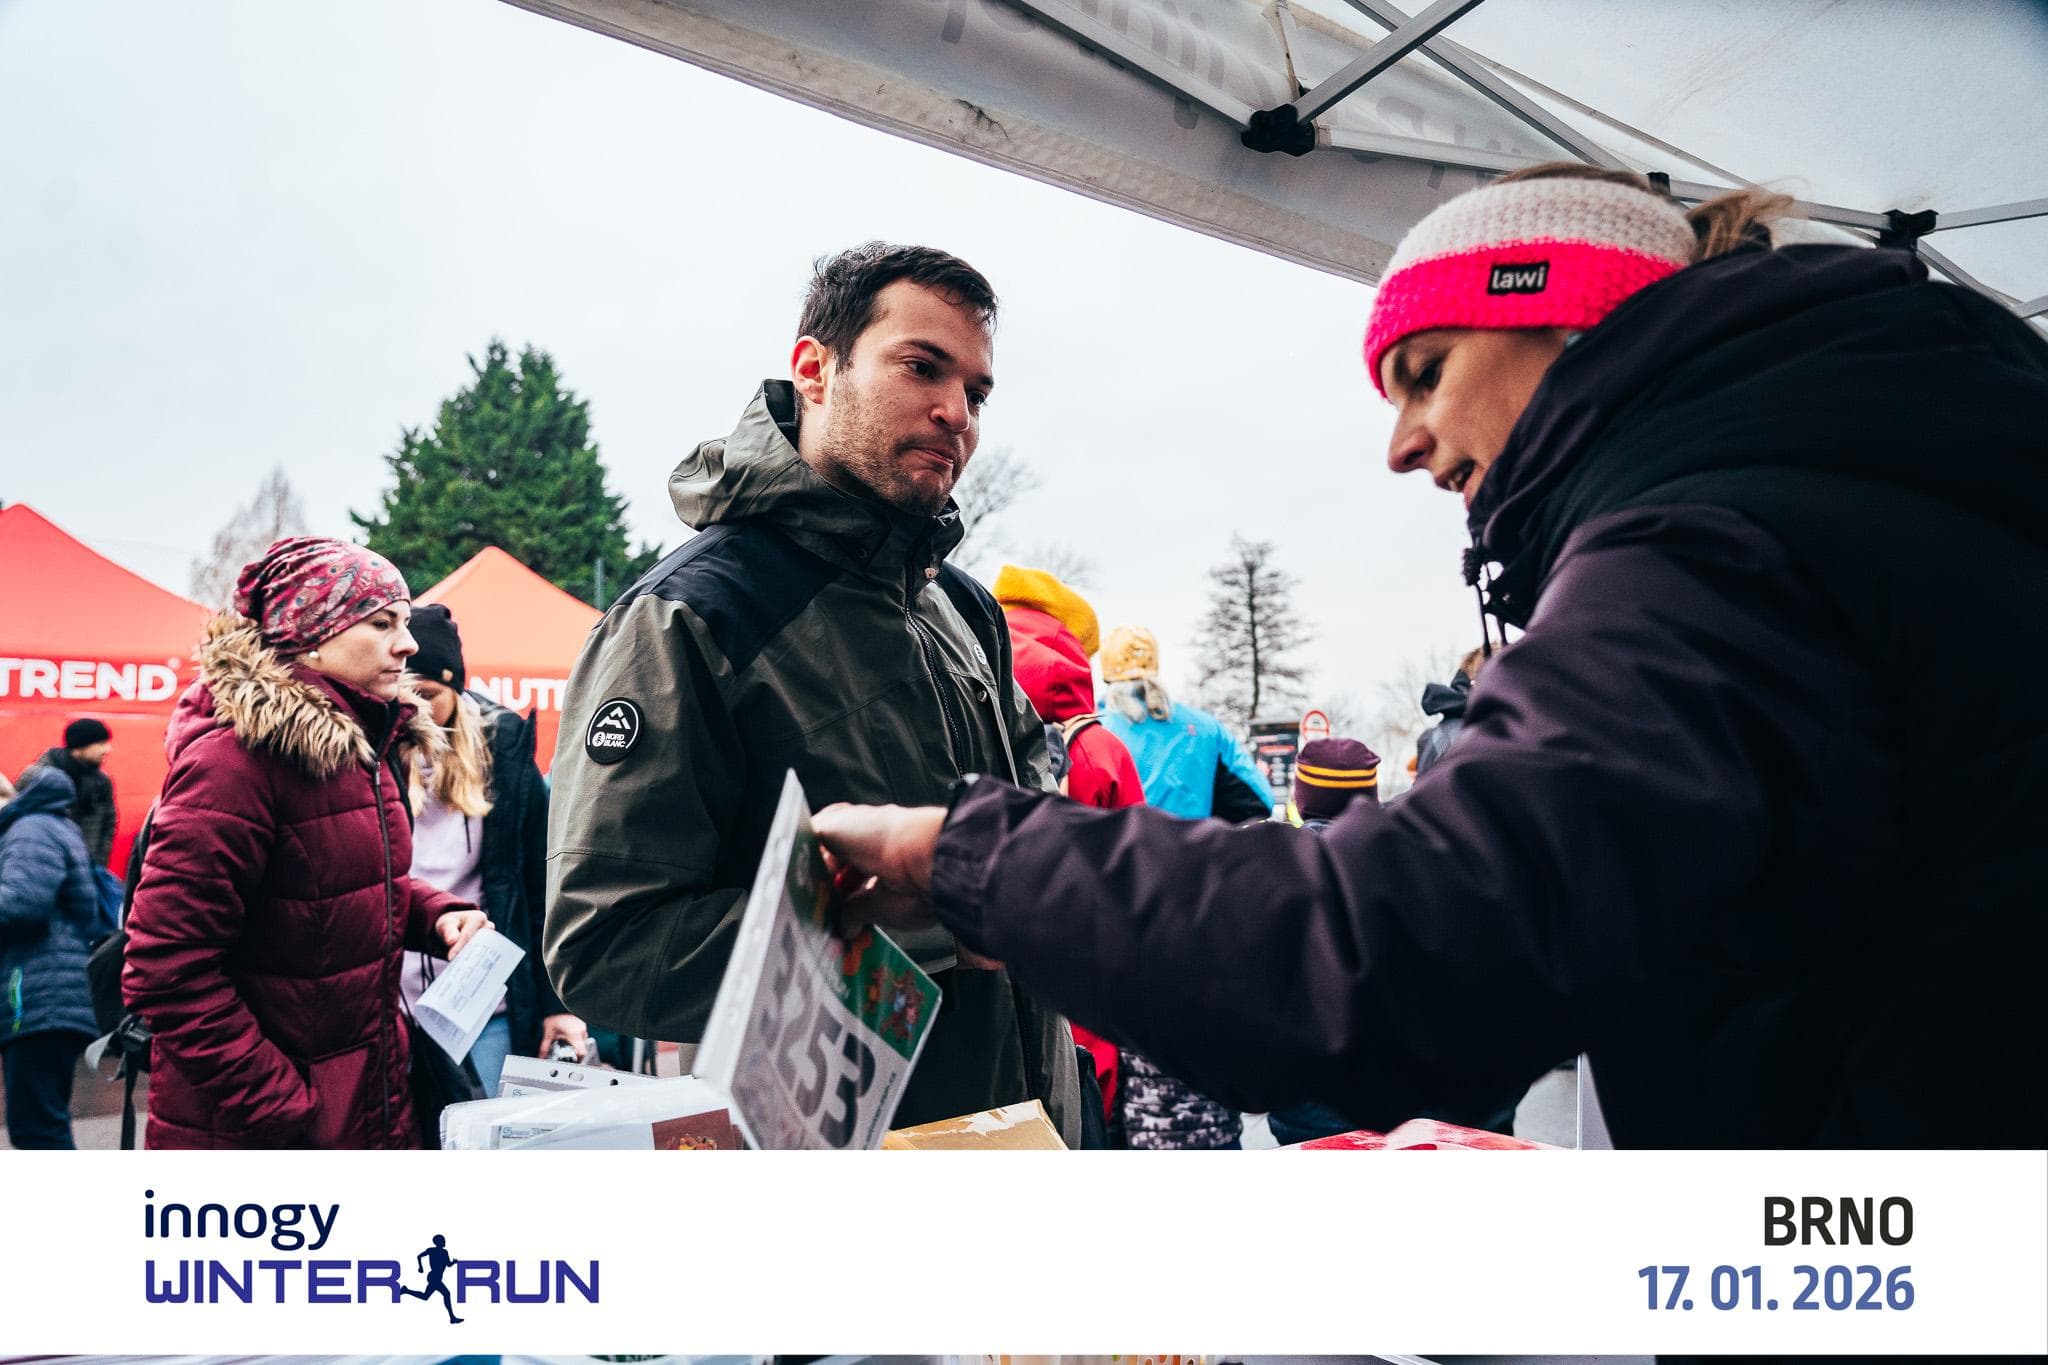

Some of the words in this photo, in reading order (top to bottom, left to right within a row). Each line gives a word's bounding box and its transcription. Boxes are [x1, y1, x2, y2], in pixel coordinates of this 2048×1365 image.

[1491, 266, 1546, 290] lawi
[605, 732, 626, 741] NORD
[602, 739, 627, 748] BLANC
